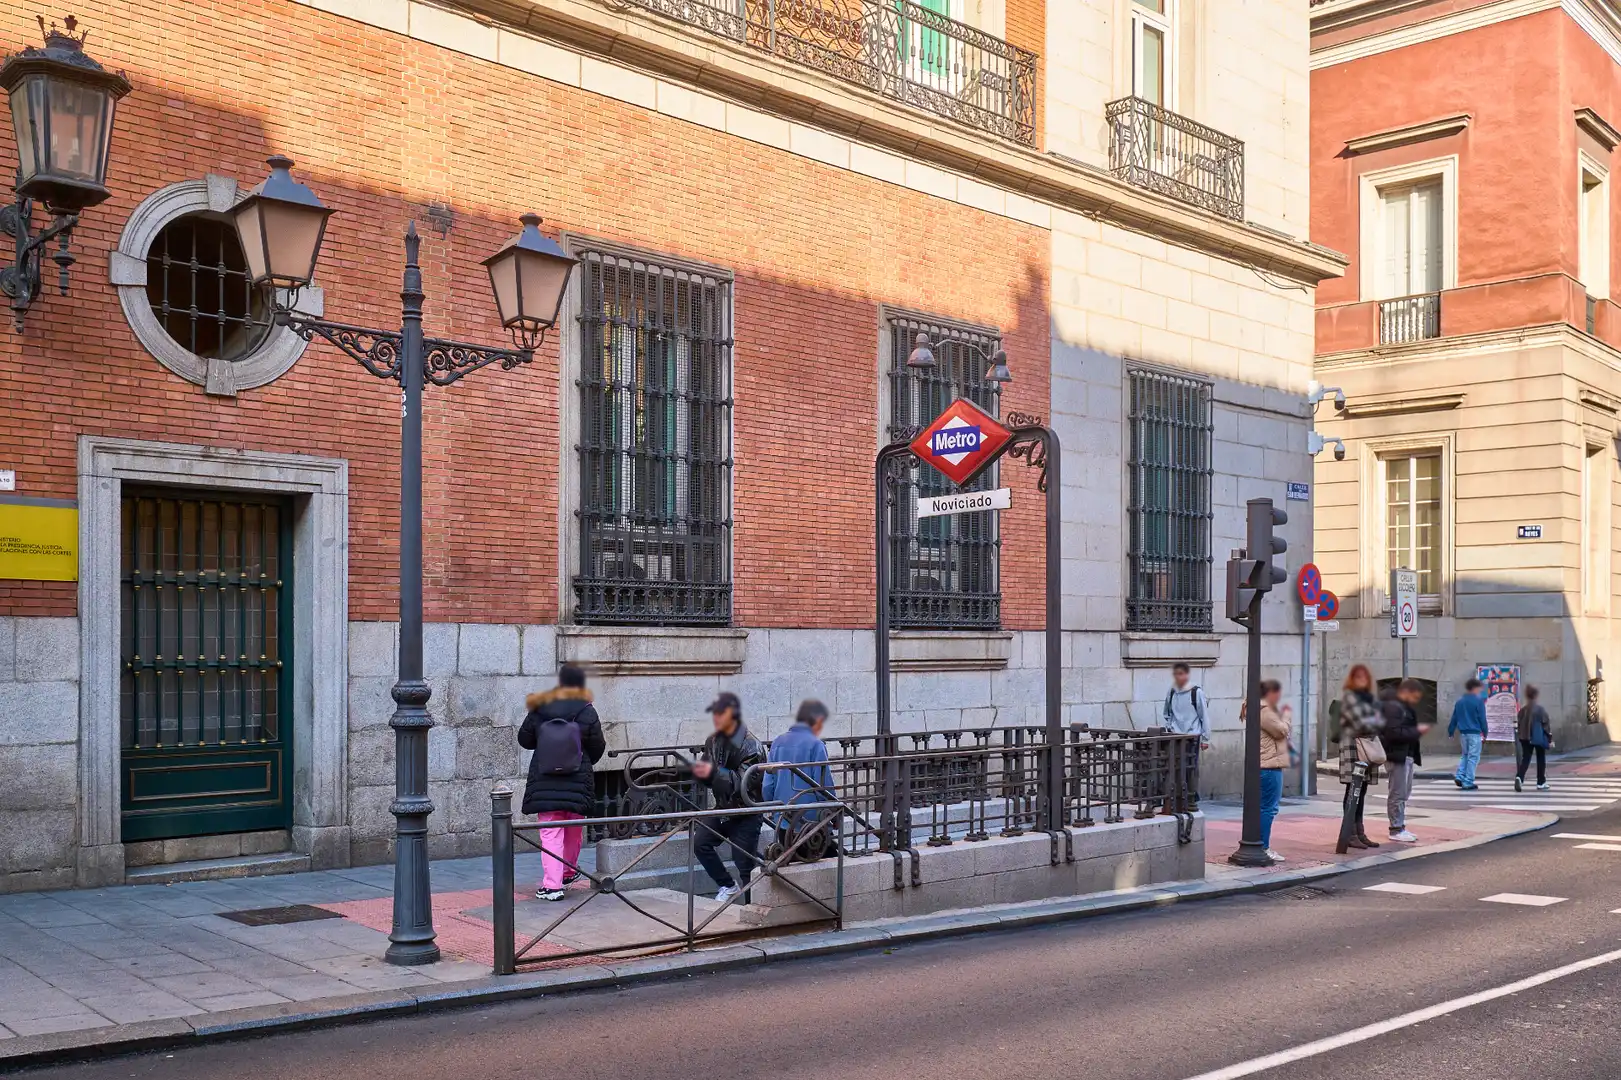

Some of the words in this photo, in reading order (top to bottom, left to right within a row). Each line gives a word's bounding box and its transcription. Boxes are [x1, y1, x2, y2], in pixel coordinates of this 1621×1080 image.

[935, 432, 977, 451] Metro
[932, 495, 992, 512] Noviciado
[1404, 612, 1412, 622] 20
